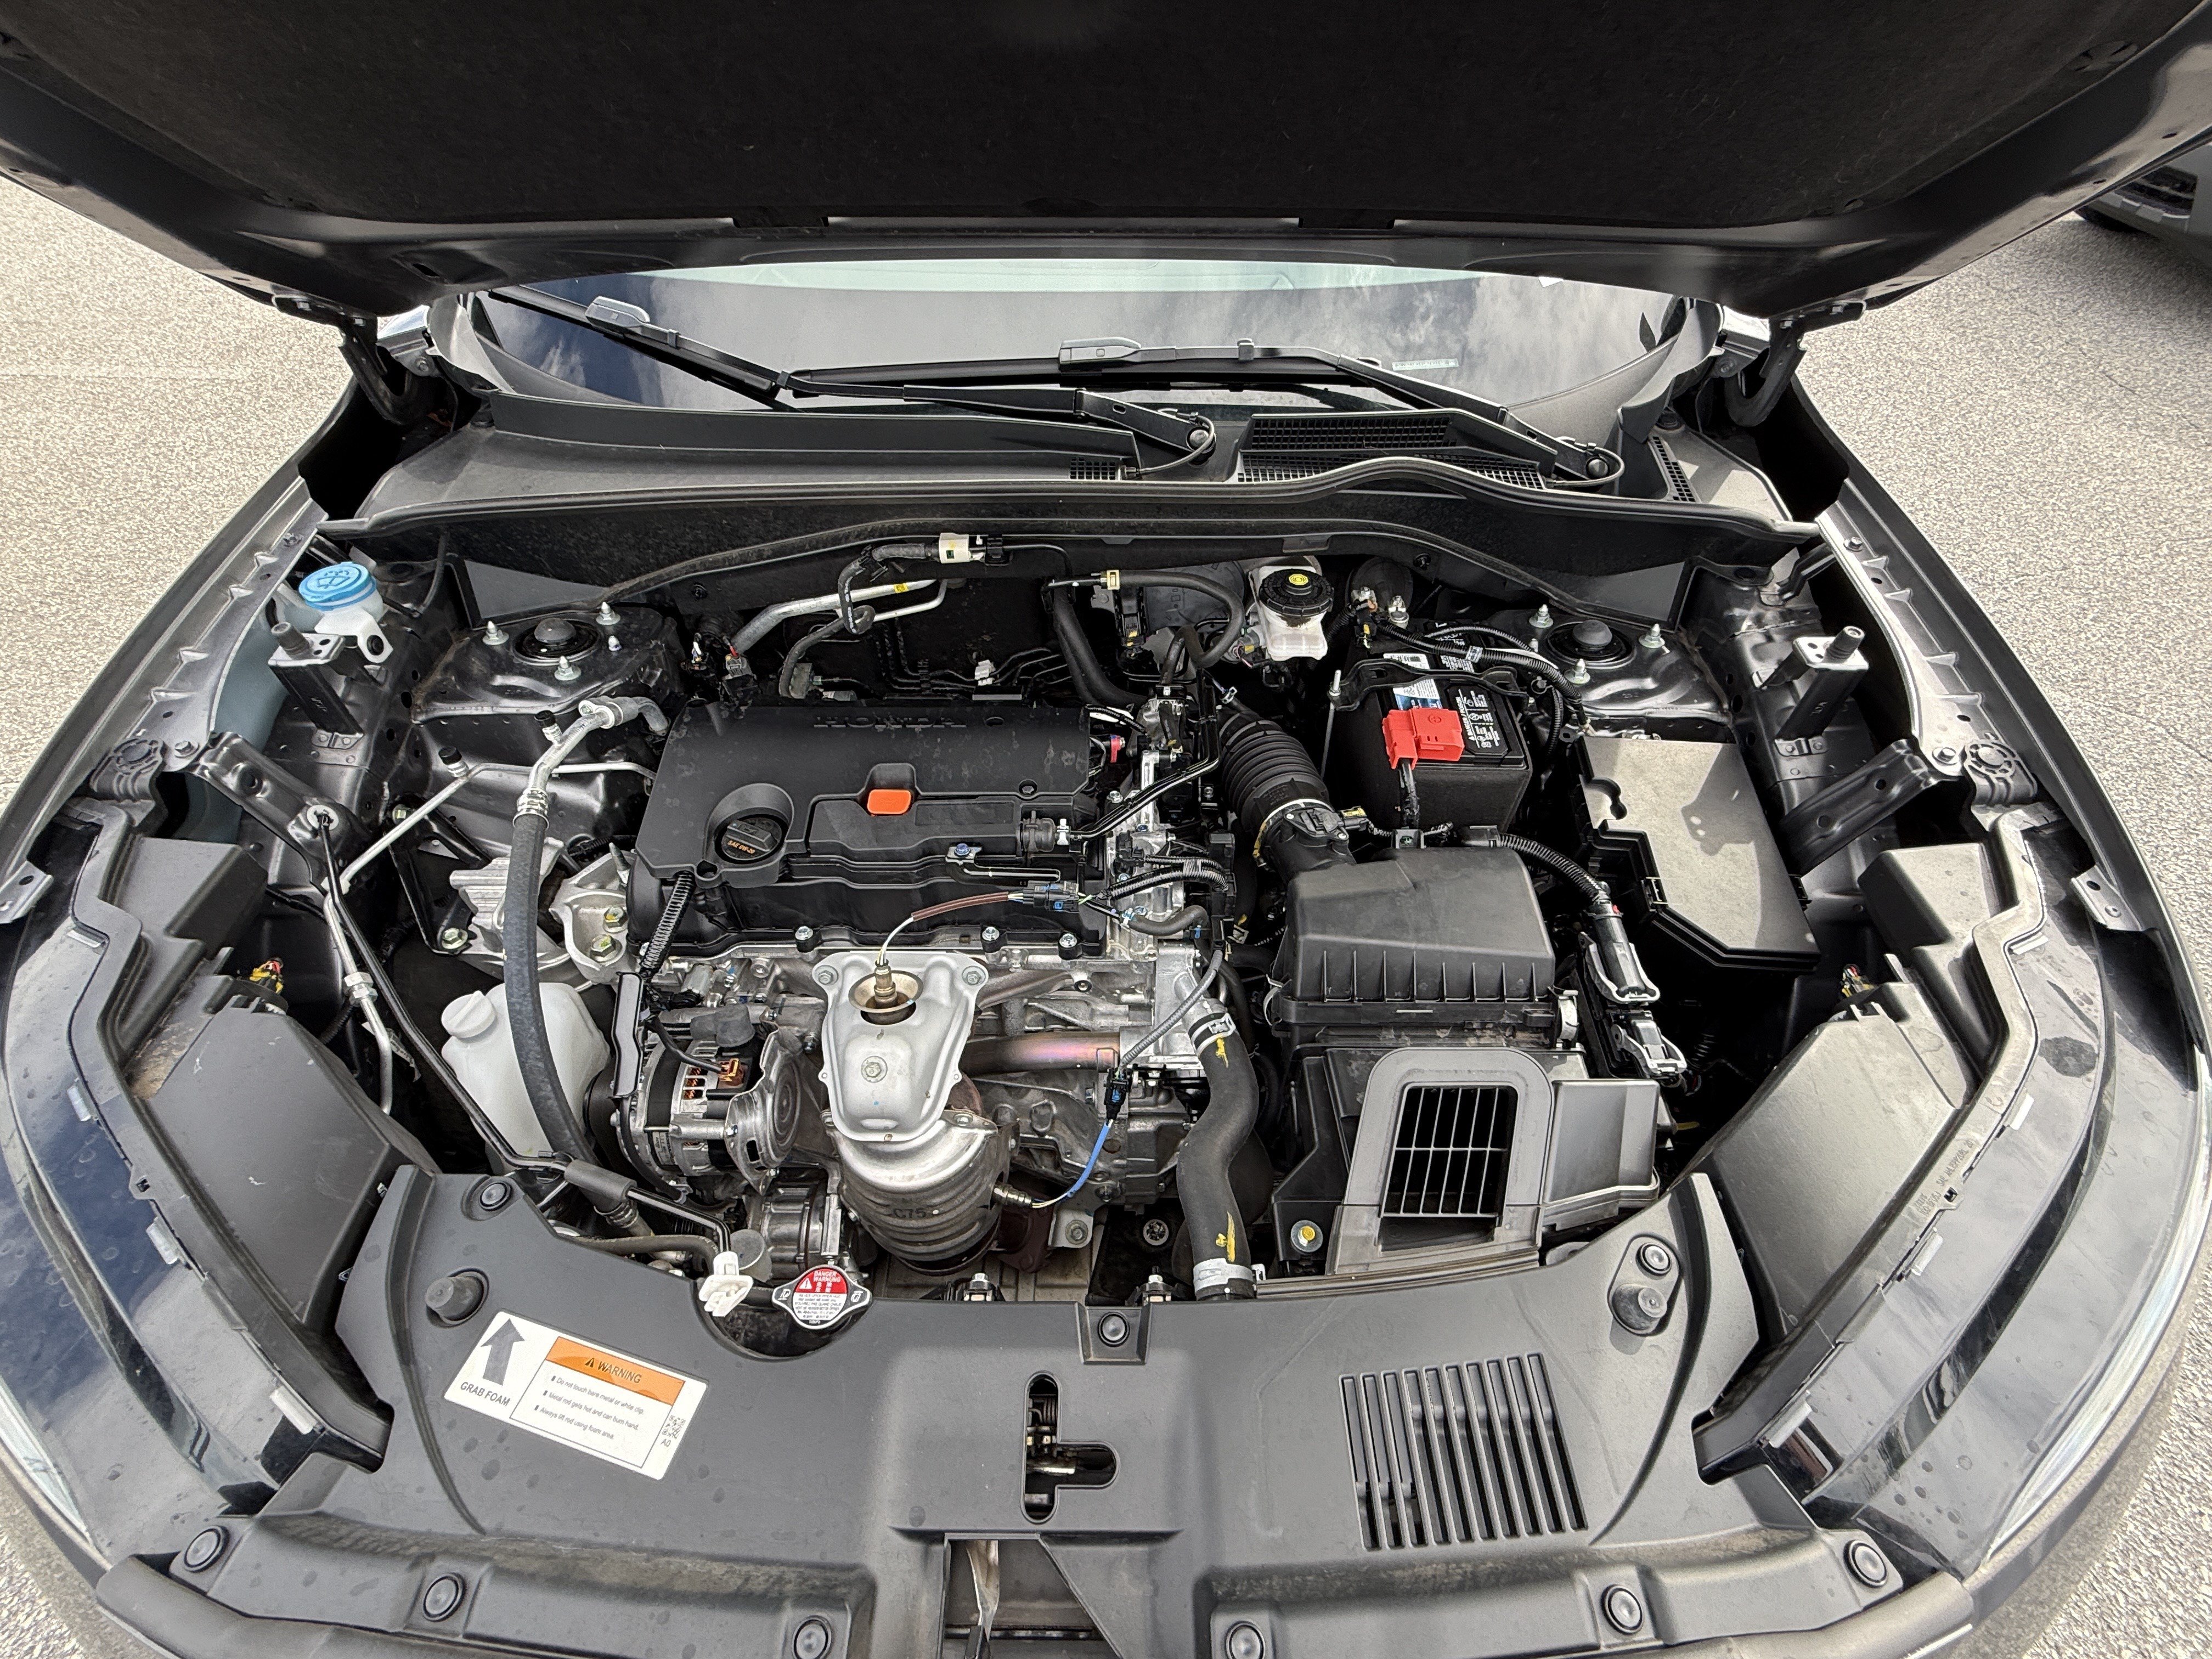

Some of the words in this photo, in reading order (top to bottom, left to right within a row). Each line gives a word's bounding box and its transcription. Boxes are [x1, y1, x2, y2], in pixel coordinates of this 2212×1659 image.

[814, 716, 967, 732] HONDA
[727, 840, 741, 848] SAE
[738, 845, 755, 854] 0W-20
[597, 1361, 642, 1383] WARNING
[460, 1381, 485, 1396] GRAB
[484, 1390, 510, 1406] FOAM
[573, 1383, 587, 1393] touch
[588, 1389, 599, 1398] bare
[599, 1393, 614, 1403] metal
[620, 1401, 634, 1410] white
[540, 1407, 557, 1419] Always
[574, 1421, 588, 1431] using
[588, 1424, 601, 1434] foam
[549, 1392, 563, 1402] Metal
[562, 1397, 572, 1405] rod
[571, 1401, 583, 1410] gets
[592, 1408, 602, 1417] and
[612, 1415, 624, 1425] burn
